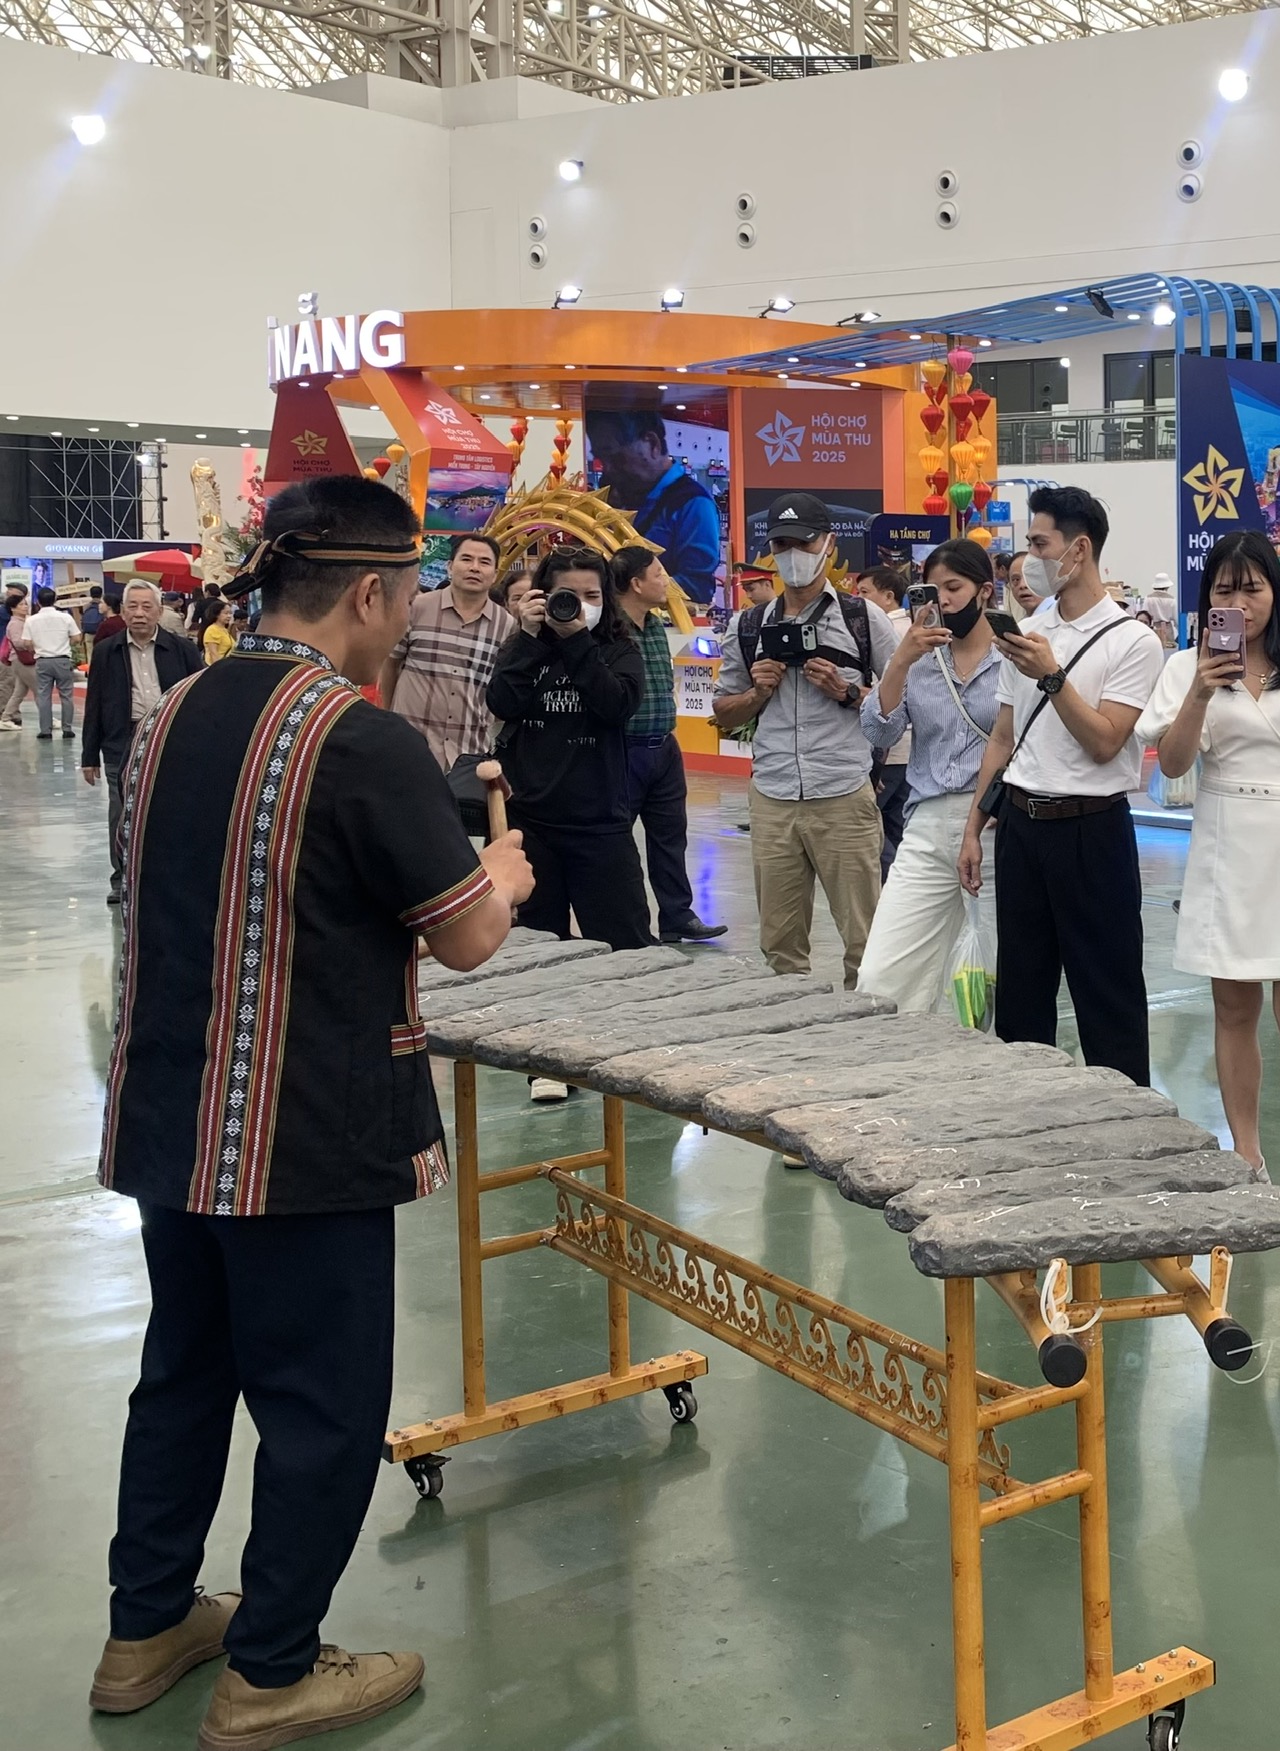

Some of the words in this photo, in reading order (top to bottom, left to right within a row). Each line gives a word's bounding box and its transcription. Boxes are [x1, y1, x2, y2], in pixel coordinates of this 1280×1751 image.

[273, 292, 406, 381] NẴNG
[811, 412, 835, 430] HỘI
[837, 414, 867, 430] CHỢ
[811, 430, 842, 445] MÙA
[844, 433, 871, 446] THU
[812, 450, 847, 463] 2025
[1189, 531, 1214, 552] HỘI
[1187, 553, 1208, 571] MÙ
[684, 666, 697, 679] HỘI
[685, 680, 700, 692] MÙA
[685, 697, 703, 710] 2025
